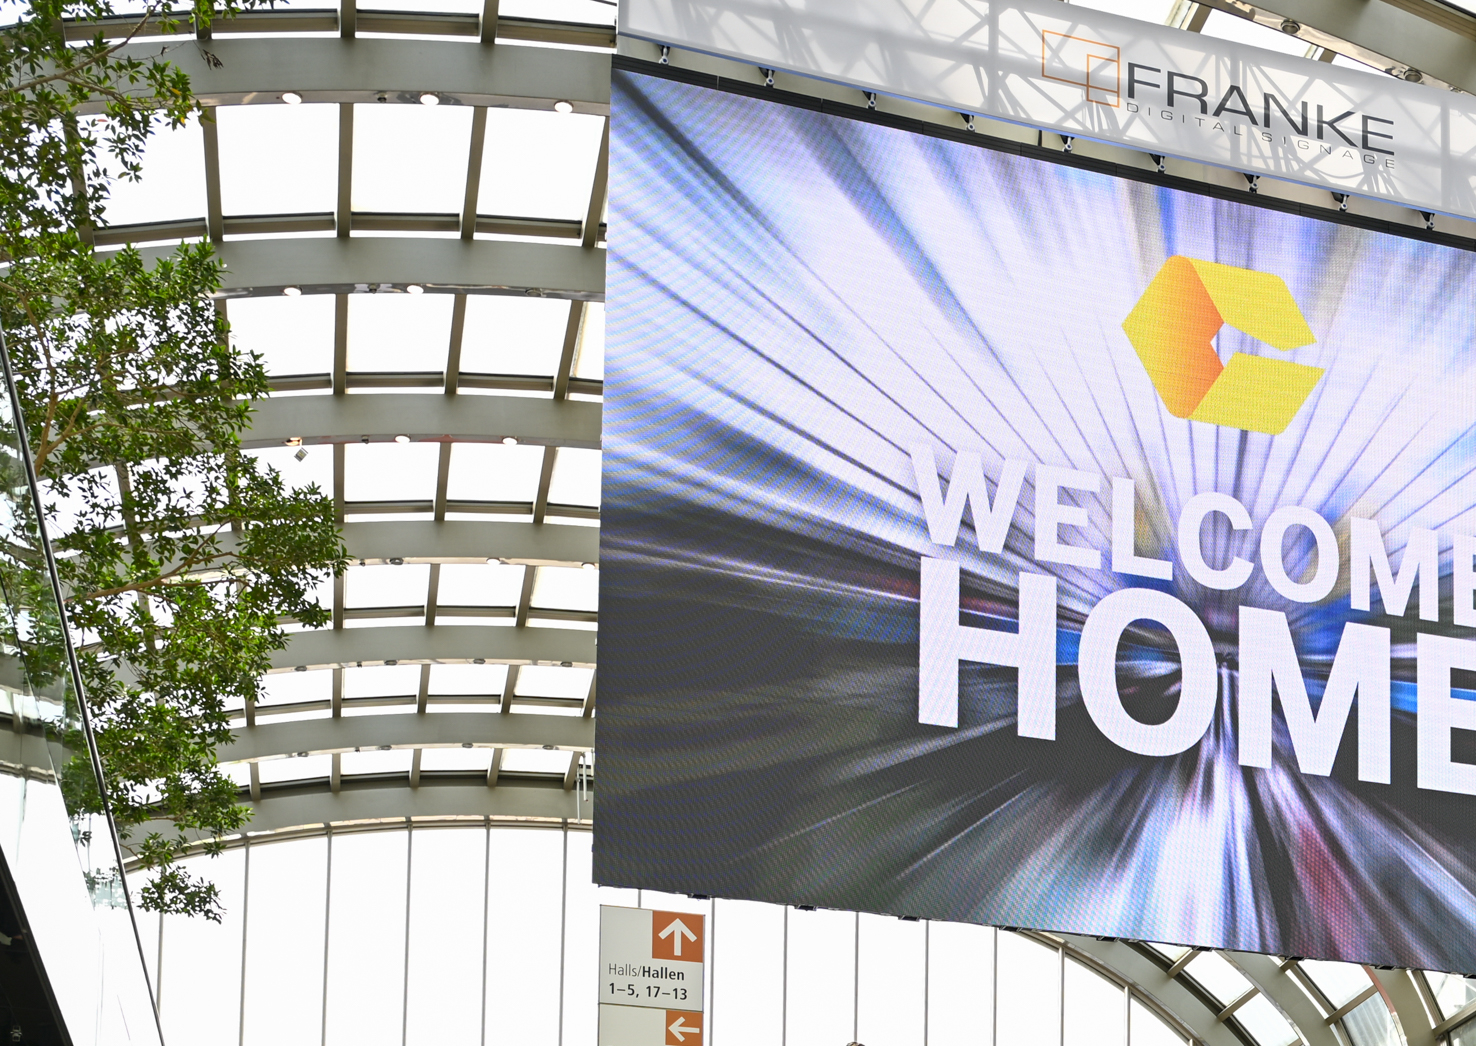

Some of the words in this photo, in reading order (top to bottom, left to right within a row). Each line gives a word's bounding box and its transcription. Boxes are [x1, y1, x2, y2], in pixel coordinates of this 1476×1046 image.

[1127, 102, 1243, 136] DIGITAL
[1262, 132, 1395, 169] SIGNAGE
[1128, 62, 1395, 156] FRANKE
[608, 963, 685, 981] Halls/Hallen
